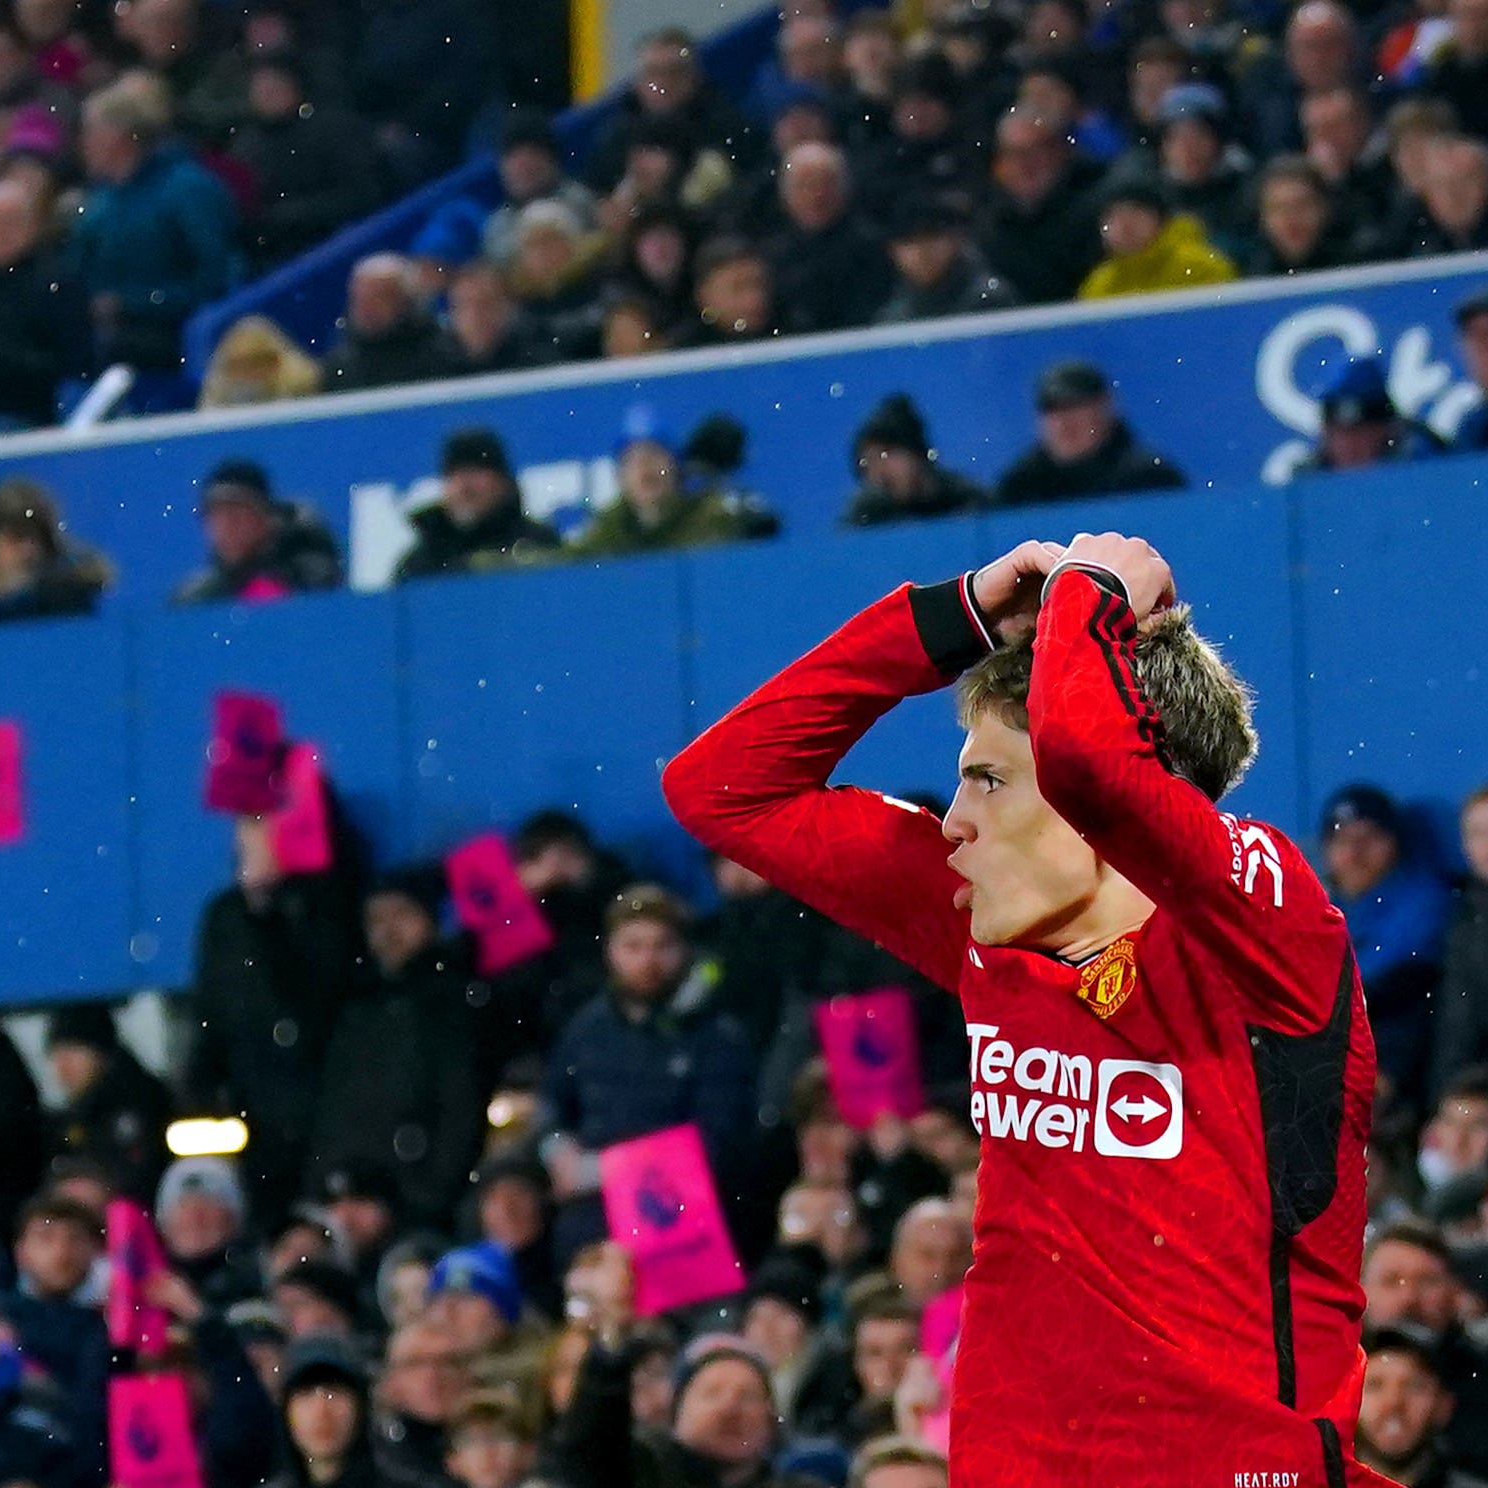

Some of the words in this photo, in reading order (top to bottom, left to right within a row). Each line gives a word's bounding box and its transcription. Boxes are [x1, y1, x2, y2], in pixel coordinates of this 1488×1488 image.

[966, 1023, 1092, 1101] Team
[970, 1090, 1090, 1152] ewer
[1234, 1472, 1299, 1488] HEAT.RDY
